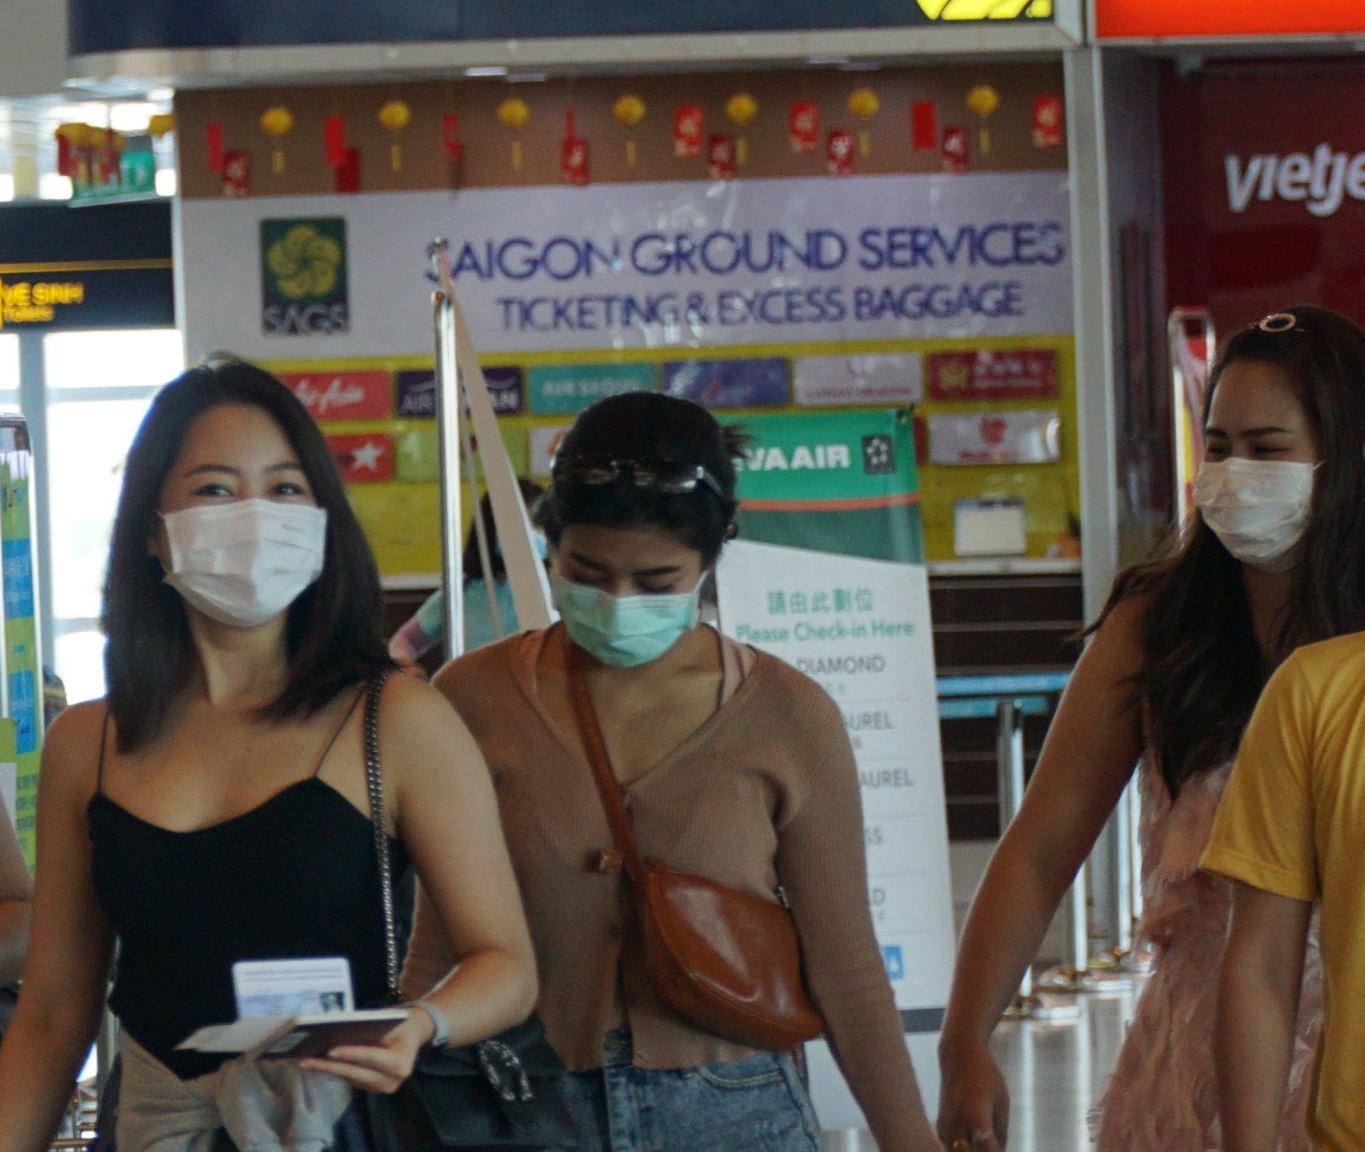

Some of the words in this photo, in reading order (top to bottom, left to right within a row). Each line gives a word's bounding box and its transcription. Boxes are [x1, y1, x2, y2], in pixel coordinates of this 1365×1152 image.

[424, 237, 621, 283] SAIGON
[631, 228, 848, 276] GROUND
[858, 219, 1066, 271] SERVICES
[263, 303, 348, 335] SAGS
[496, 291, 681, 333] TICKETING
[716, 287, 848, 327] EXCESS
[852, 280, 1025, 322] BAGGAGE
[736, 624, 789, 643] Please
[794, 620, 868, 641] Check-in
[871, 619, 915, 637] Here
[797, 655, 886, 674] DIAMOND
